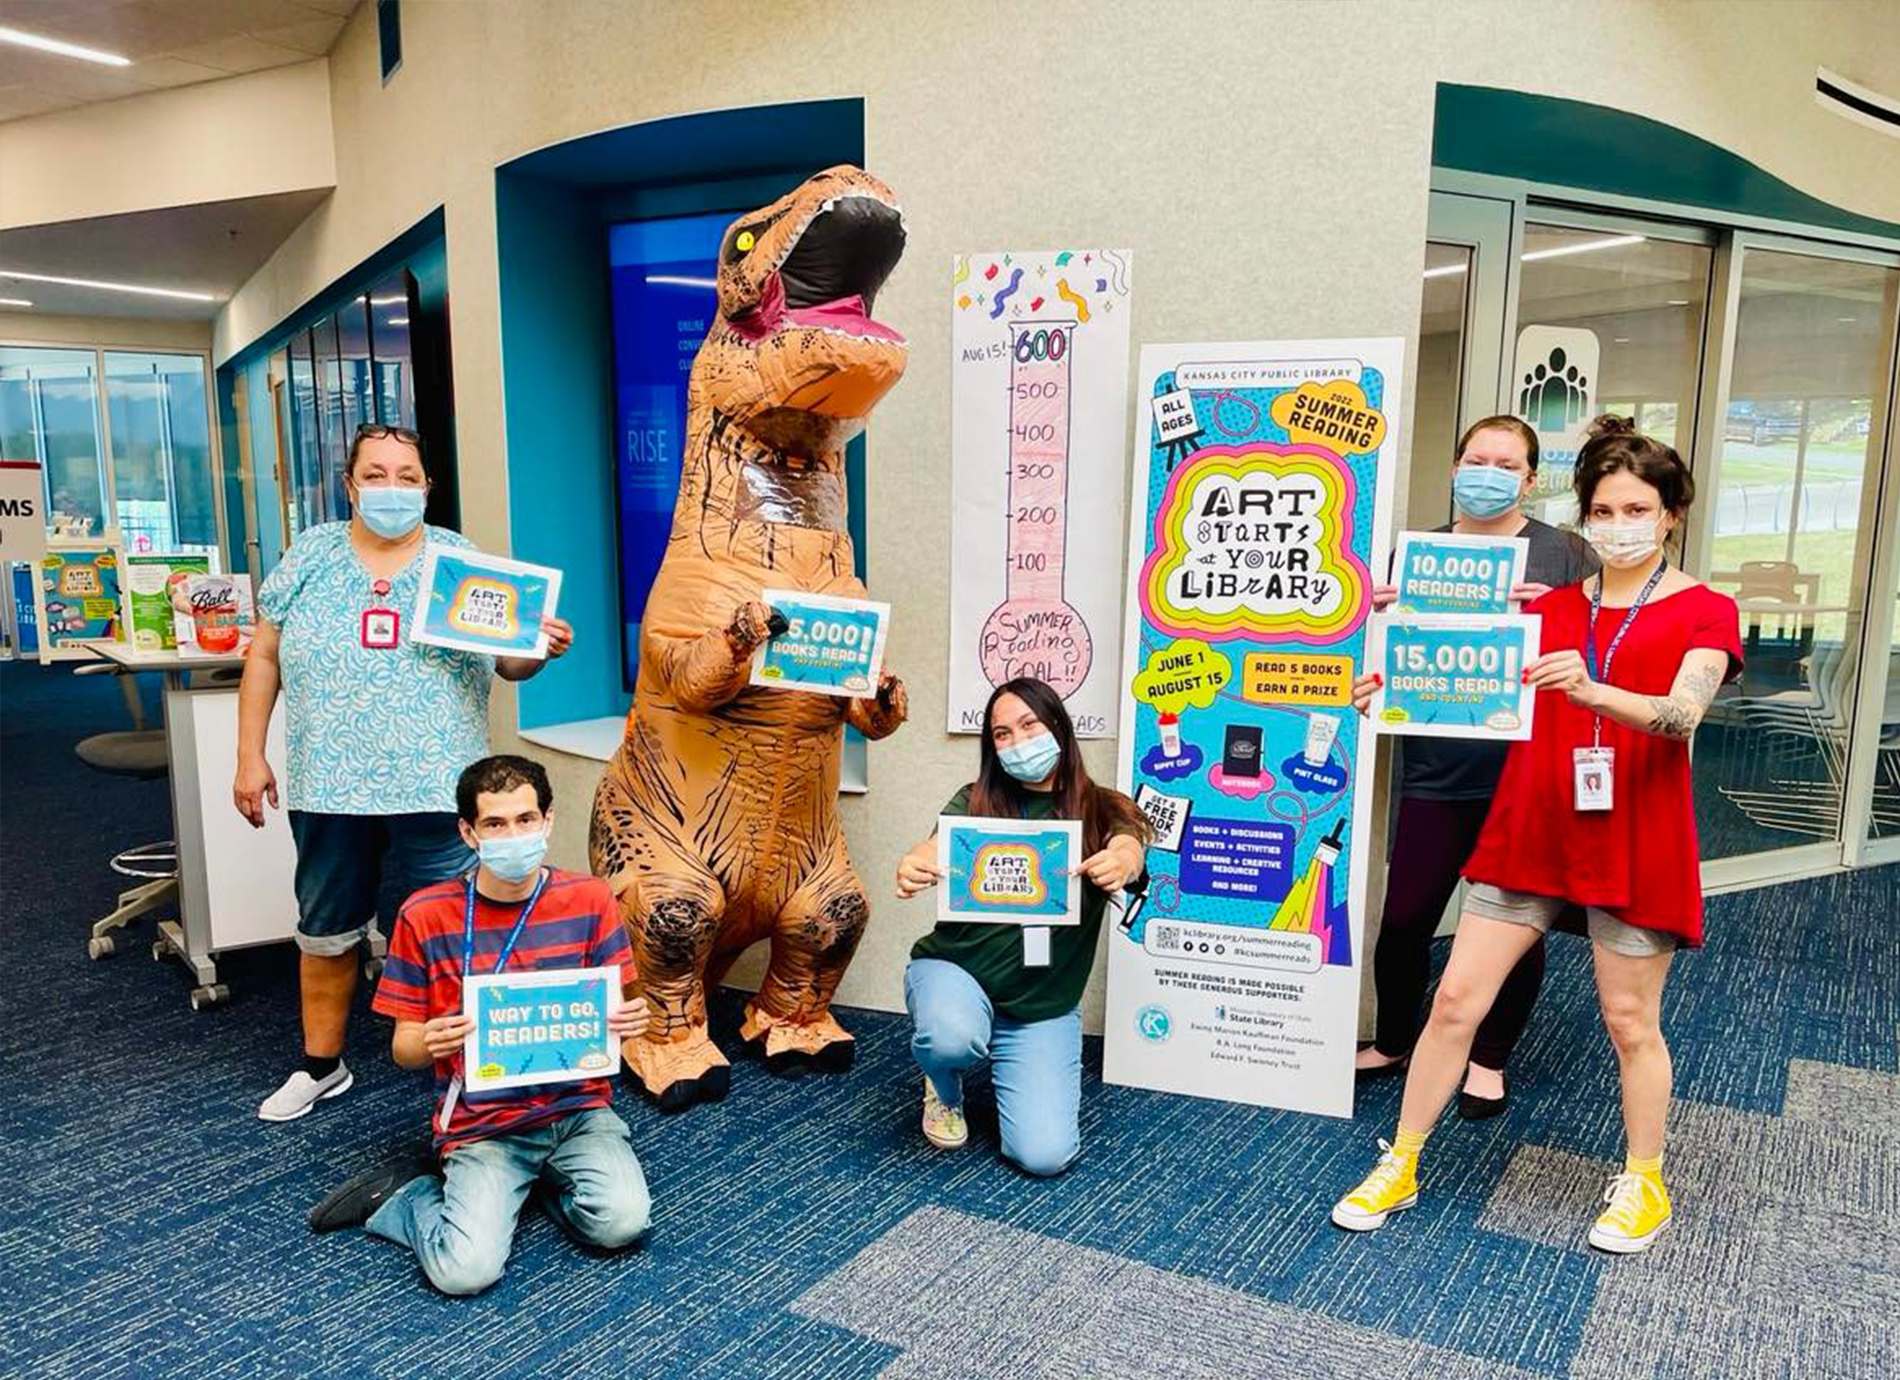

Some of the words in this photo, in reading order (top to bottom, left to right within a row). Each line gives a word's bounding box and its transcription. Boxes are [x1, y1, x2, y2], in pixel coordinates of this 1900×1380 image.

[1015, 328, 1066, 363] 600
[962, 348, 985, 361] AUG
[1183, 371, 1227, 381] KANSAS
[1230, 371, 1256, 380] CITY
[1260, 370, 1298, 379] PUBLIC
[1303, 369, 1352, 378] LIBRARY
[1016, 382, 1058, 399] 500
[1330, 393, 1353, 405] 2022
[1162, 400, 1185, 415] ALL
[1294, 395, 1379, 432] SUMMER
[1161, 414, 1193, 432] AGES
[1289, 411, 1372, 449] READING
[1015, 424, 1055, 442] 400
[627, 429, 668, 463] RISE
[1017, 464, 1054, 479] 300
[1200, 486, 1316, 517] ART
[1016, 507, 1056, 523] 200
[1016, 553, 1046, 571] 100
[471, 588, 508, 604] ART
[1406, 579, 1490, 600] READERS
[190, 588, 234, 612] Ball
[1000, 612, 1073, 642] SUMMER
[771, 641, 819, 659] BOOKS
[821, 647, 858, 662] READ
[984, 630, 1080, 663] Reading
[1157, 653, 1194, 673] JUNE
[1198, 652, 1205, 664] 1
[1255, 662, 1286, 673] READ
[1290, 663, 1298, 674] 5
[1302, 664, 1342, 676] BOOKS
[1147, 676, 1202, 699] AUGUST
[1206, 672, 1223, 686] 15
[1256, 683, 1287, 694] EARN
[1291, 684, 1299, 695] A
[1303, 685, 1339, 697] PRIZE
[1391, 676, 1449, 692] BOOKS
[1454, 677, 1499, 693] READ
[1176, 758, 1192, 768] CUP
[1313, 774, 1339, 788] GLASS
[1151, 794, 1168, 805] GET
[1144, 801, 1178, 822] FREE
[1148, 815, 1174, 834] OOK
[1193, 826, 1219, 835] BOOKS
[1230, 828, 1284, 840] DISCUSSIONS
[1194, 840, 1225, 849] EVENTS
[1236, 843, 1281, 854] ACTIVITIES
[990, 857, 1028, 867] ART
[1191, 854, 1231, 864] LEARNING
[1242, 858, 1282, 869] CREATIVE
[1212, 865, 1259, 876] RESOURCES
[1212, 881, 1229, 890] AND
[1231, 883, 1257, 893] MORE!
[1183, 929, 1312, 951] kclibrary.org/summerreading
[1234, 948, 1311, 964] #kcsummerreads
[1154, 968, 1189, 979] SUMMER
[1191, 972, 1226, 984] READING
[1228, 976, 1237, 986] IS
[1239, 977, 1263, 988] MADE
[1265, 981, 1305, 994] POSSIBLE
[1158, 978, 1169, 986] BY
[1172, 980, 1198, 990] THESE
[1200, 983, 1243, 995] GENEROUS
[488, 1005, 533, 1024] WAY
[538, 1003, 563, 1020] TO
[569, 1001, 600, 1019] GO,
[1229, 1013, 1252, 1024] State
[1253, 1016, 1284, 1029] Library
[487, 1022, 600, 1047] READERS!
[1281, 1034, 1325, 1046] Foundation
[1253, 1044, 1296, 1056] Foundation
[1210, 1052, 1238, 1062] Edward
[1281, 1060, 1301, 1070] Trust
